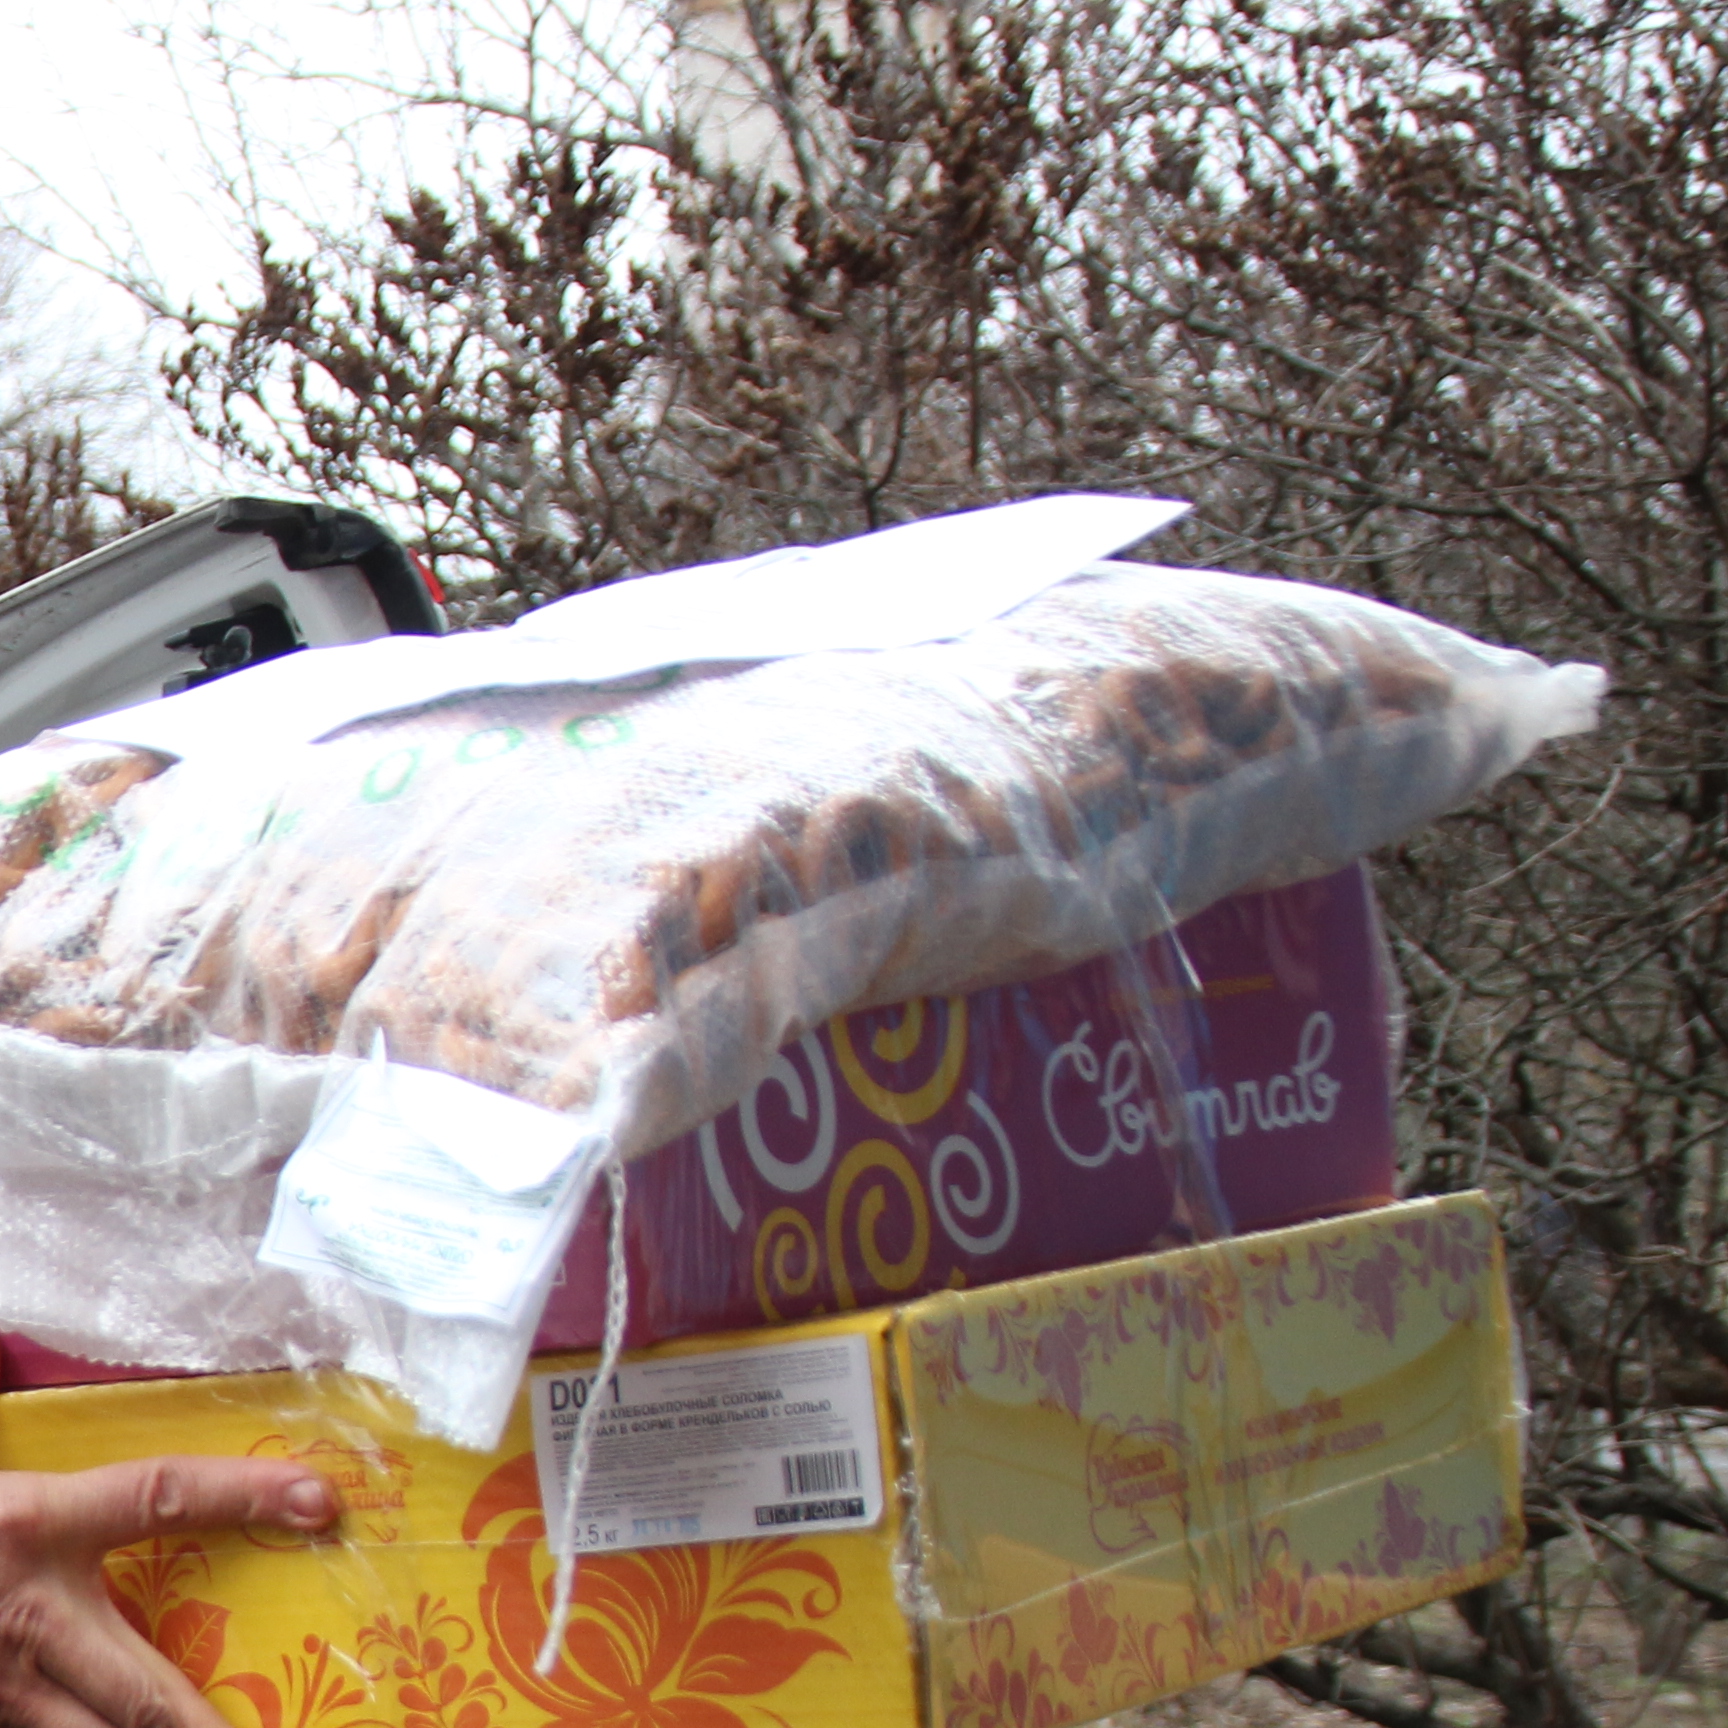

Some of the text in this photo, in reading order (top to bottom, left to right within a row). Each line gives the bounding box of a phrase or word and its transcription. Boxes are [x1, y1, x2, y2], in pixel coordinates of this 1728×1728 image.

[551, 1388, 784, 1427] ИЗДЕЯ ХЛЕБОБУЛОЧНЫЕ СОЛОМКА
[553, 1421, 617, 1442] ФИГАЯ
[631, 1416, 676, 1434] ФОРМЕ
[679, 1406, 769, 1428] КРЕНДЕЛЬКОВ
[784, 1399, 831, 1416] СОЛЬЮ
